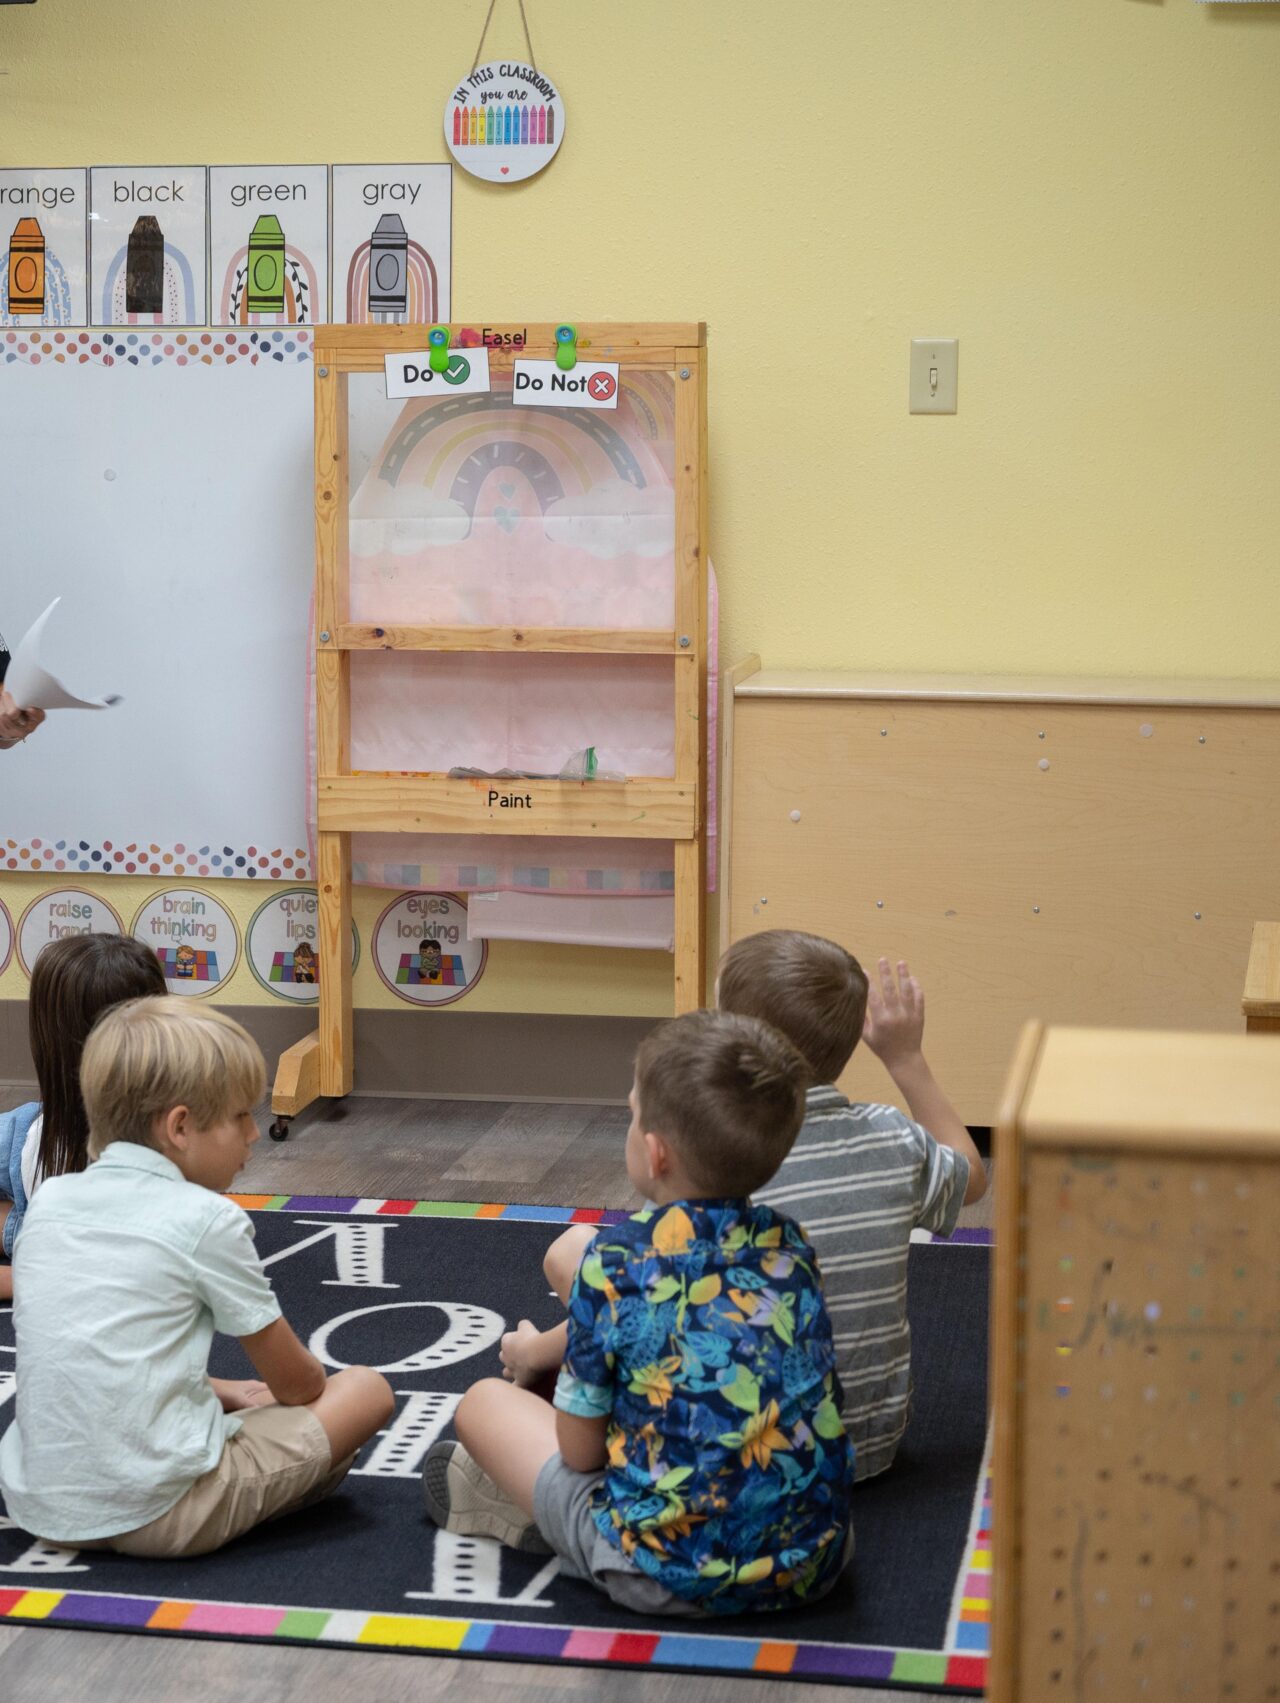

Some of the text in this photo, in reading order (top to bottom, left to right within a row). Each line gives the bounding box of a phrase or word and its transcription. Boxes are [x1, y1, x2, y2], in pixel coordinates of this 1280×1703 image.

[453, 64, 557, 104] IN THIS CLASSROOM
[480, 89, 528, 105] you are
[113, 180, 185, 203] black
[230, 184, 307, 206] green
[362, 183, 422, 206] gray
[481, 328, 528, 346] Easel
[403, 364, 434, 384] Do
[515, 372, 588, 393] Do Not
[488, 790, 532, 809] Paint
[48, 900, 93, 919] raise
[162, 895, 206, 915] brain
[406, 898, 450, 919] eyes
[150, 916, 217, 942] thinking
[286, 919, 316, 941] lips
[397, 919, 460, 944] looking
[308, 1302, 507, 1374] O
